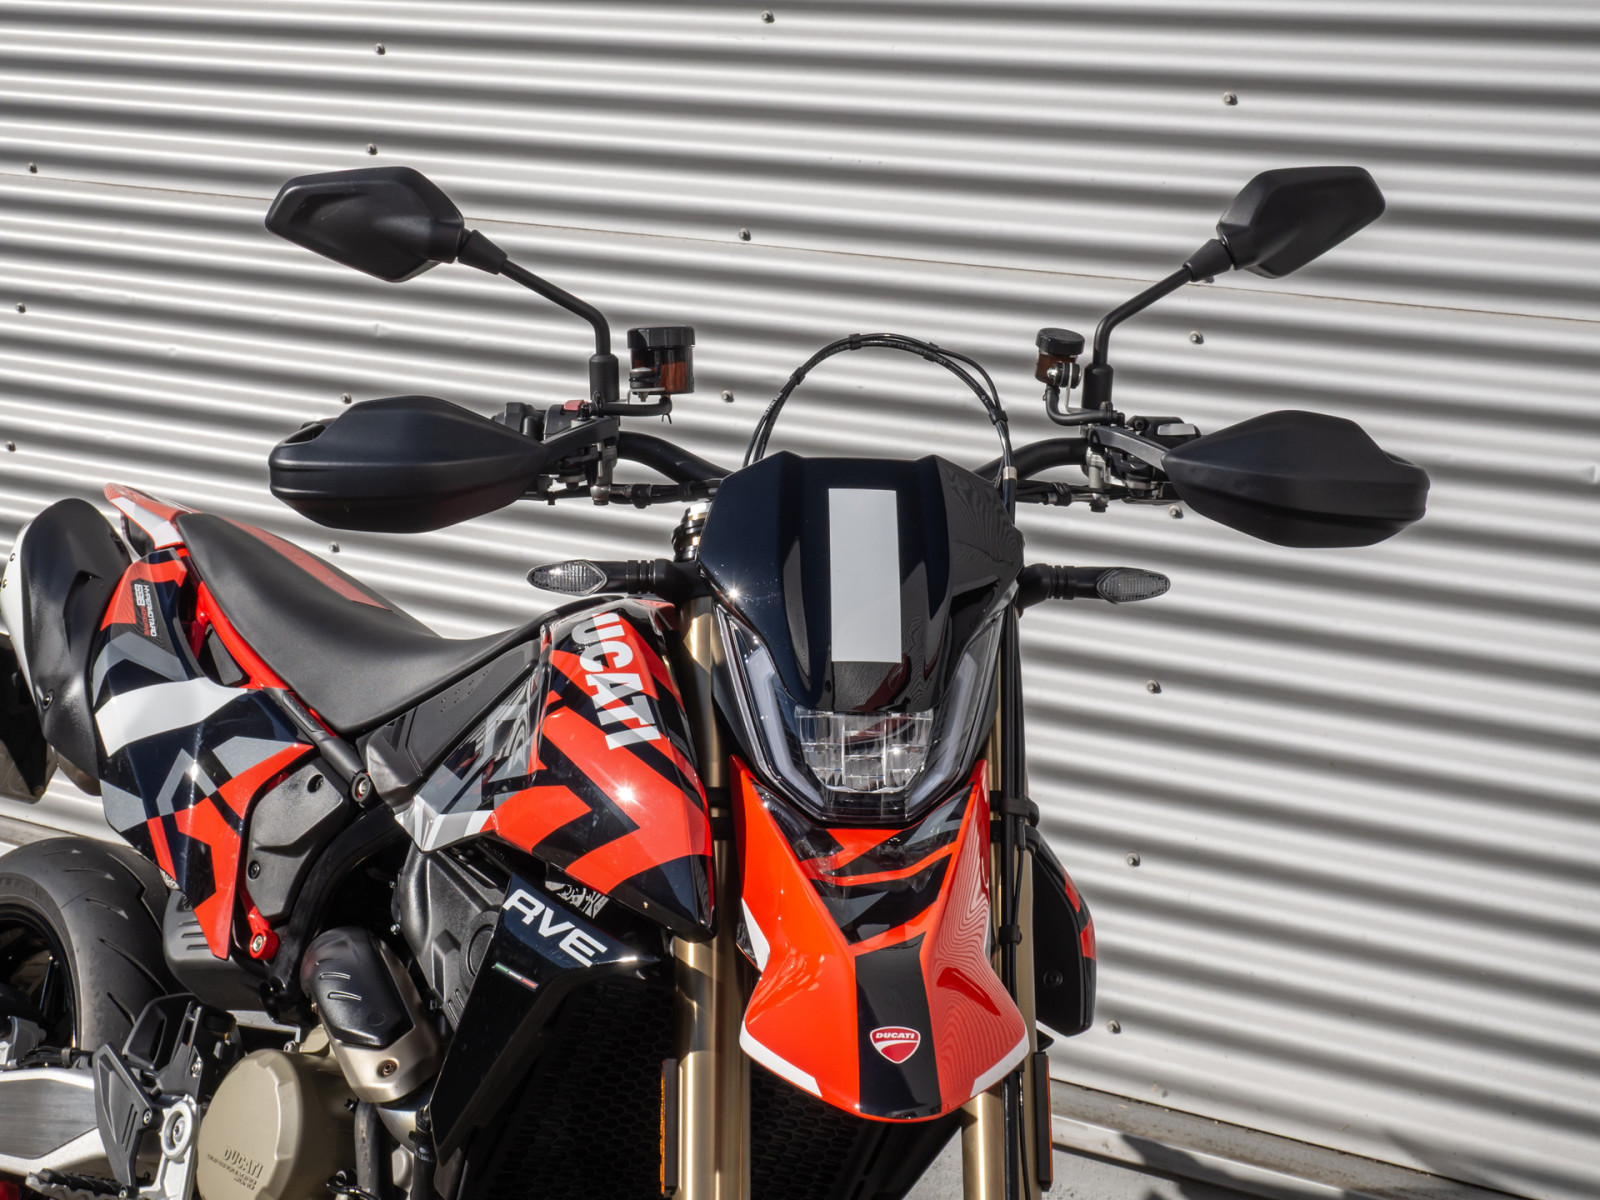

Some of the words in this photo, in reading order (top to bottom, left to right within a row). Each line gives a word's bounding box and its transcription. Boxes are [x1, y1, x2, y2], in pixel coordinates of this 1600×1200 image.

[143, 584, 157, 637] HYPERMOTARD
[502, 888, 608, 968] RVE
[222, 1147, 264, 1179] DUCATI
